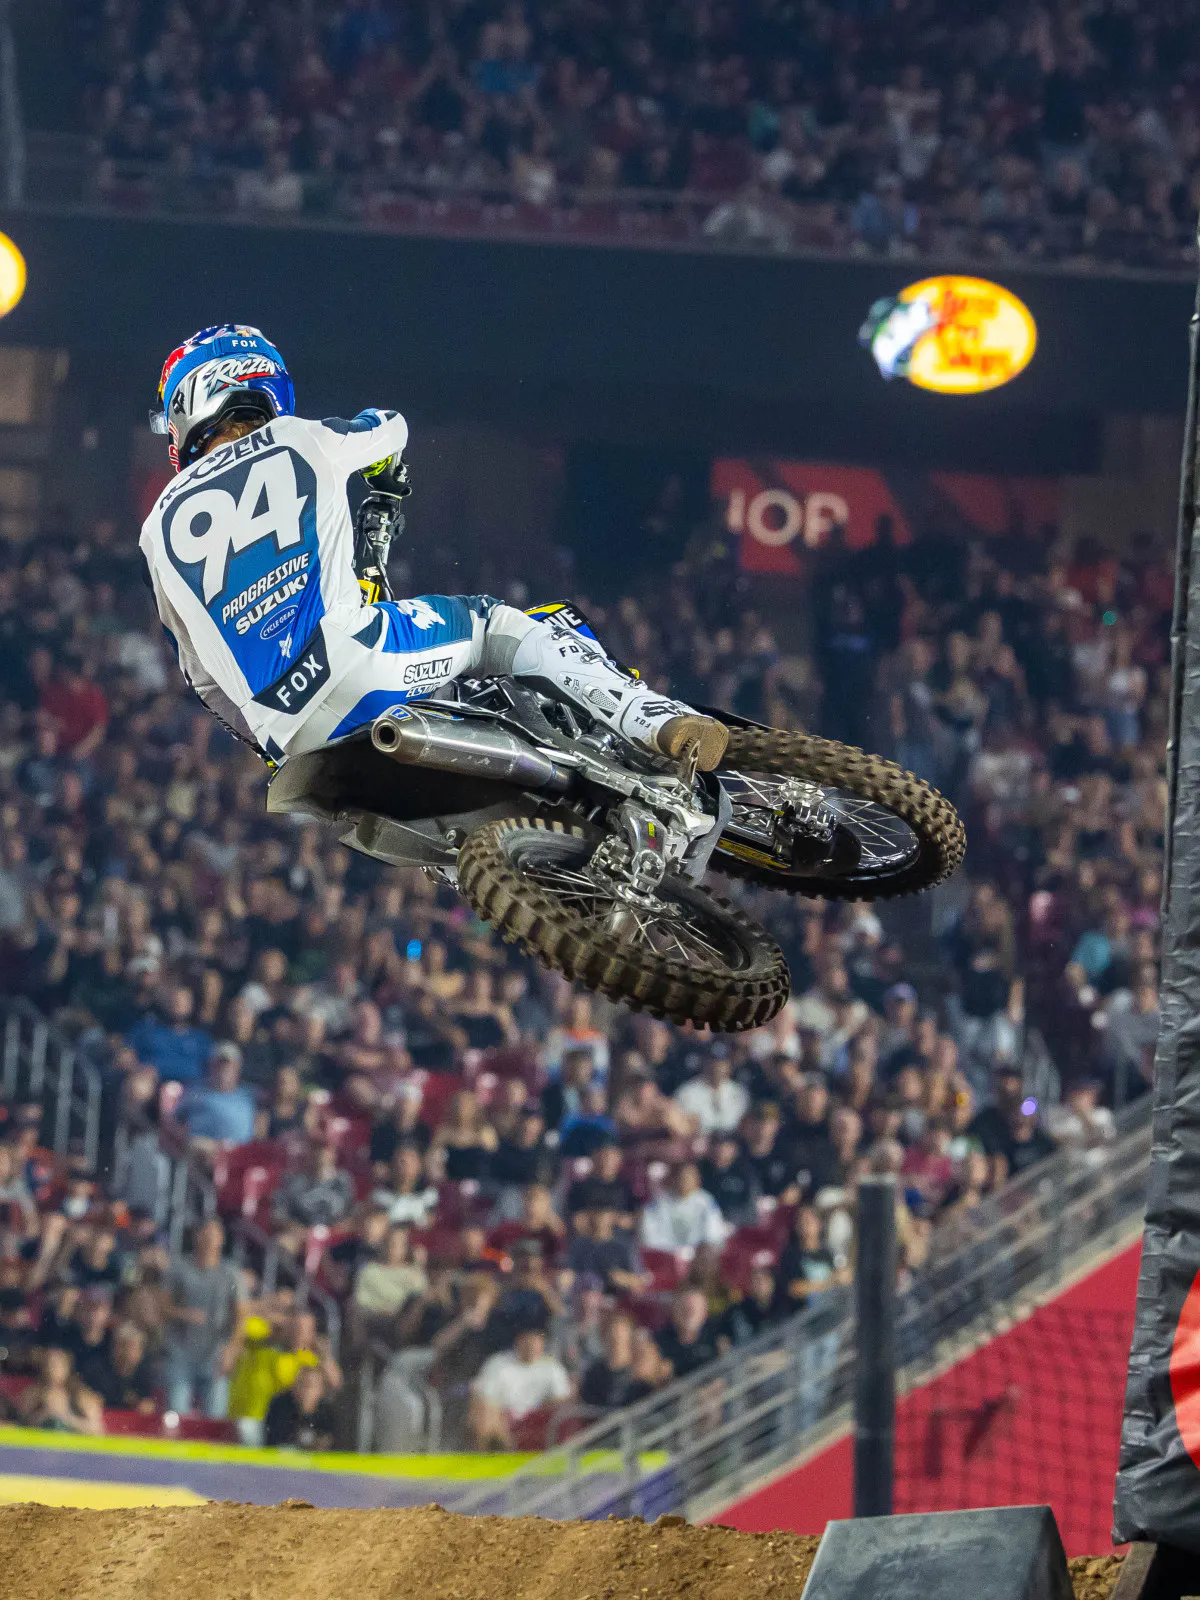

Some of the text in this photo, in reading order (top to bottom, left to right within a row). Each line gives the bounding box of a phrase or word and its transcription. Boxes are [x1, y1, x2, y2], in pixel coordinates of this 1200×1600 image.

[231, 339, 258, 348] FOX
[169, 449, 309, 605] 94
[222, 552, 309, 625] PROGRESSIVE
[235, 572, 309, 636] SUZUKI
[262, 609, 296, 637] CYCLE GEAR
[275, 653, 324, 708] FOX
[403, 657, 453, 685] SUZUKI
[634, 716, 651, 729] FOX
